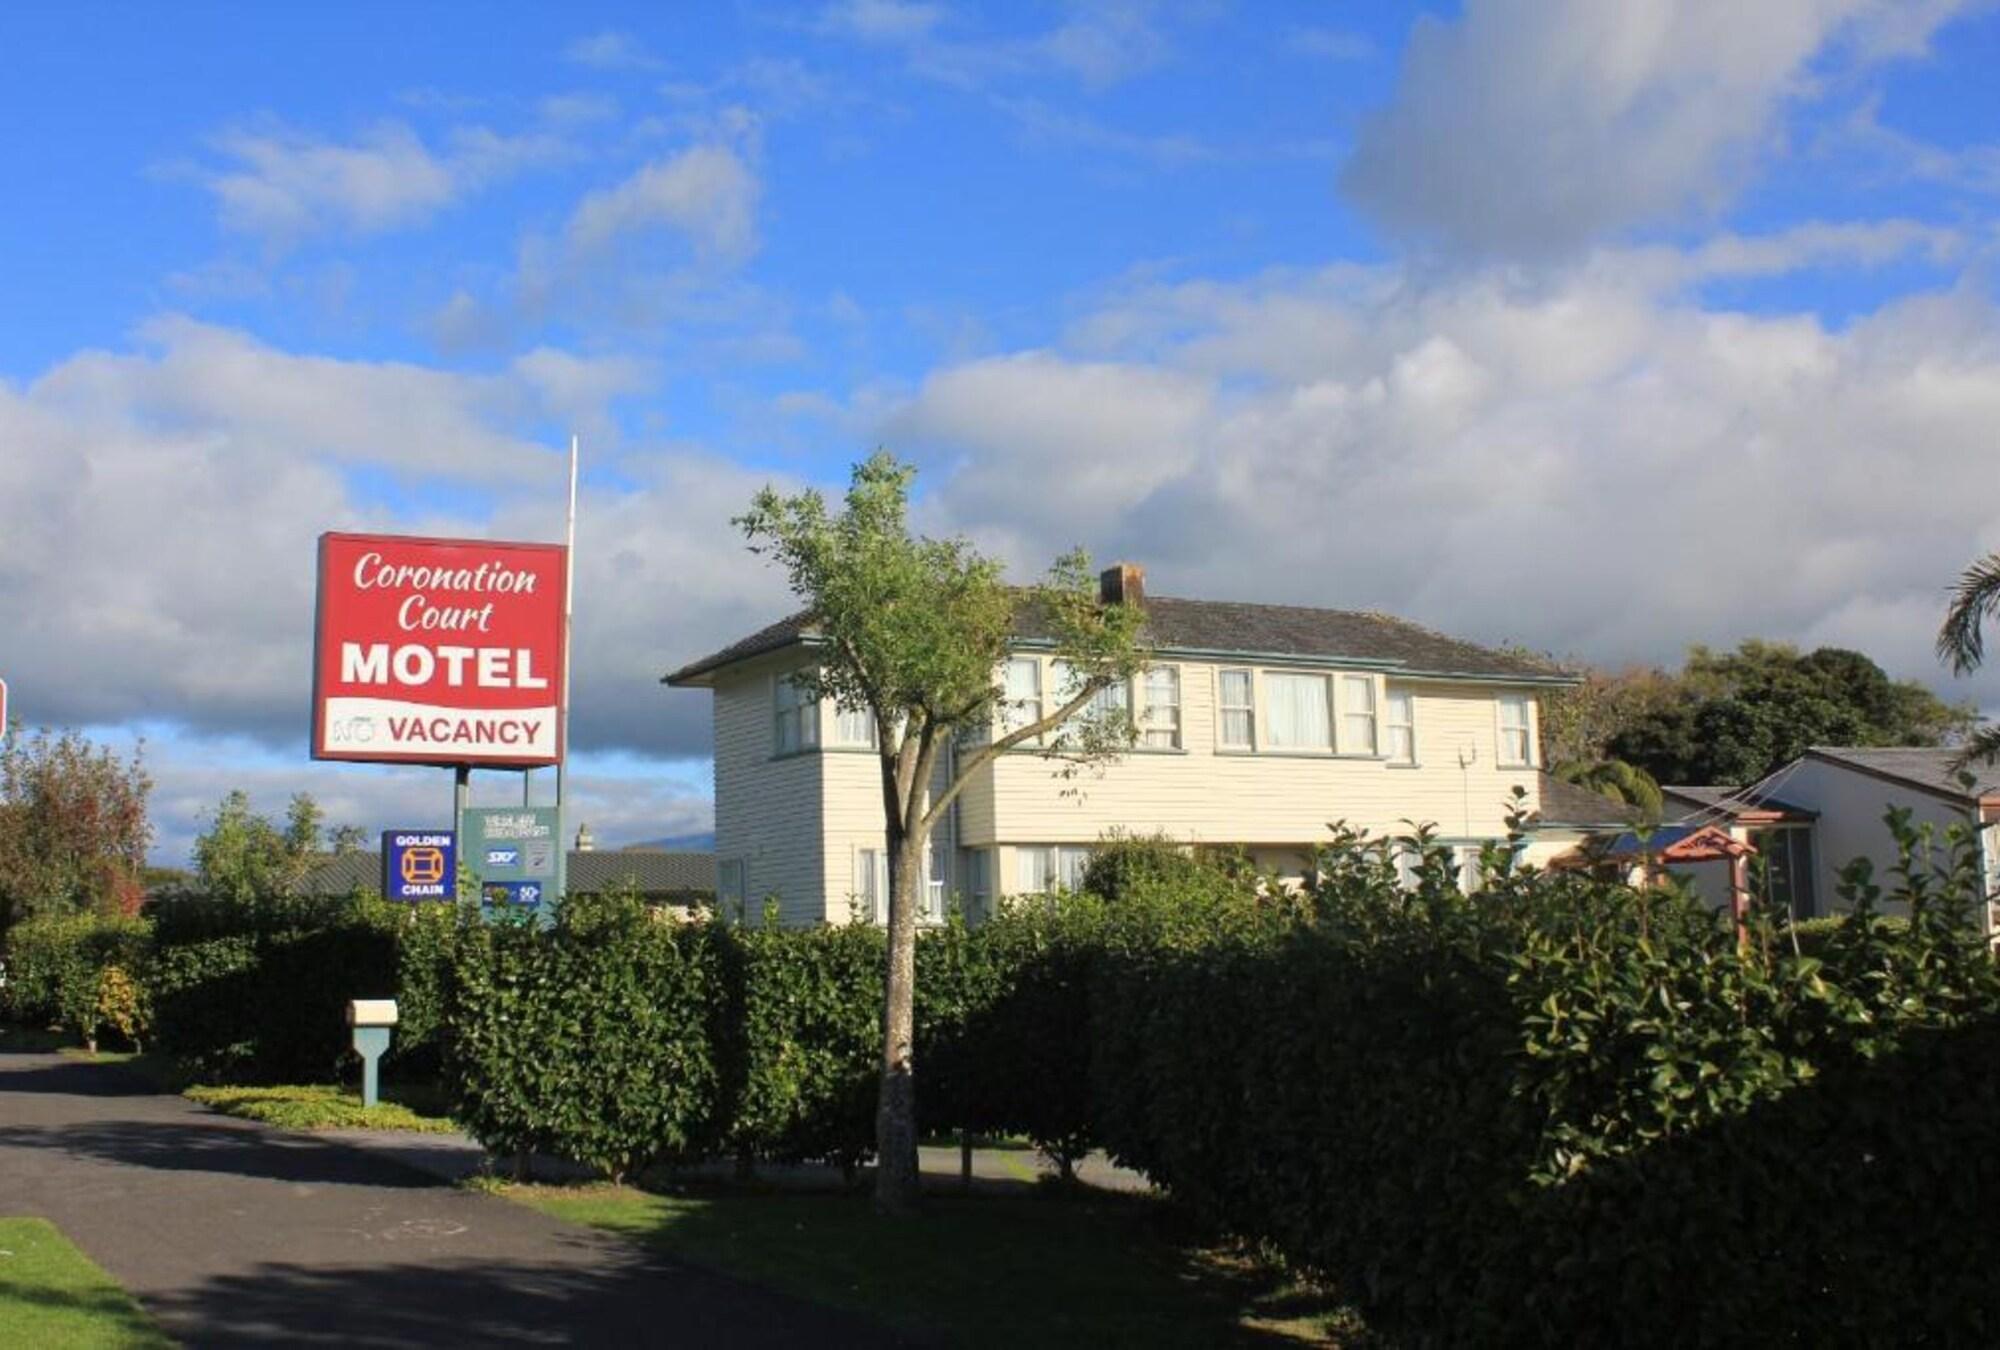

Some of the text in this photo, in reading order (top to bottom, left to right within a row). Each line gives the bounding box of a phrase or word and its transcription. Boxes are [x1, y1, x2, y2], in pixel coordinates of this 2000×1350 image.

[354, 552, 536, 593] Coronation
[398, 594, 494, 632] Court
[341, 641, 548, 688] MOTEL
[388, 716, 541, 745] VACANCY
[396, 835, 451, 847] GOLDEN
[402, 885, 444, 895] CHAIN
